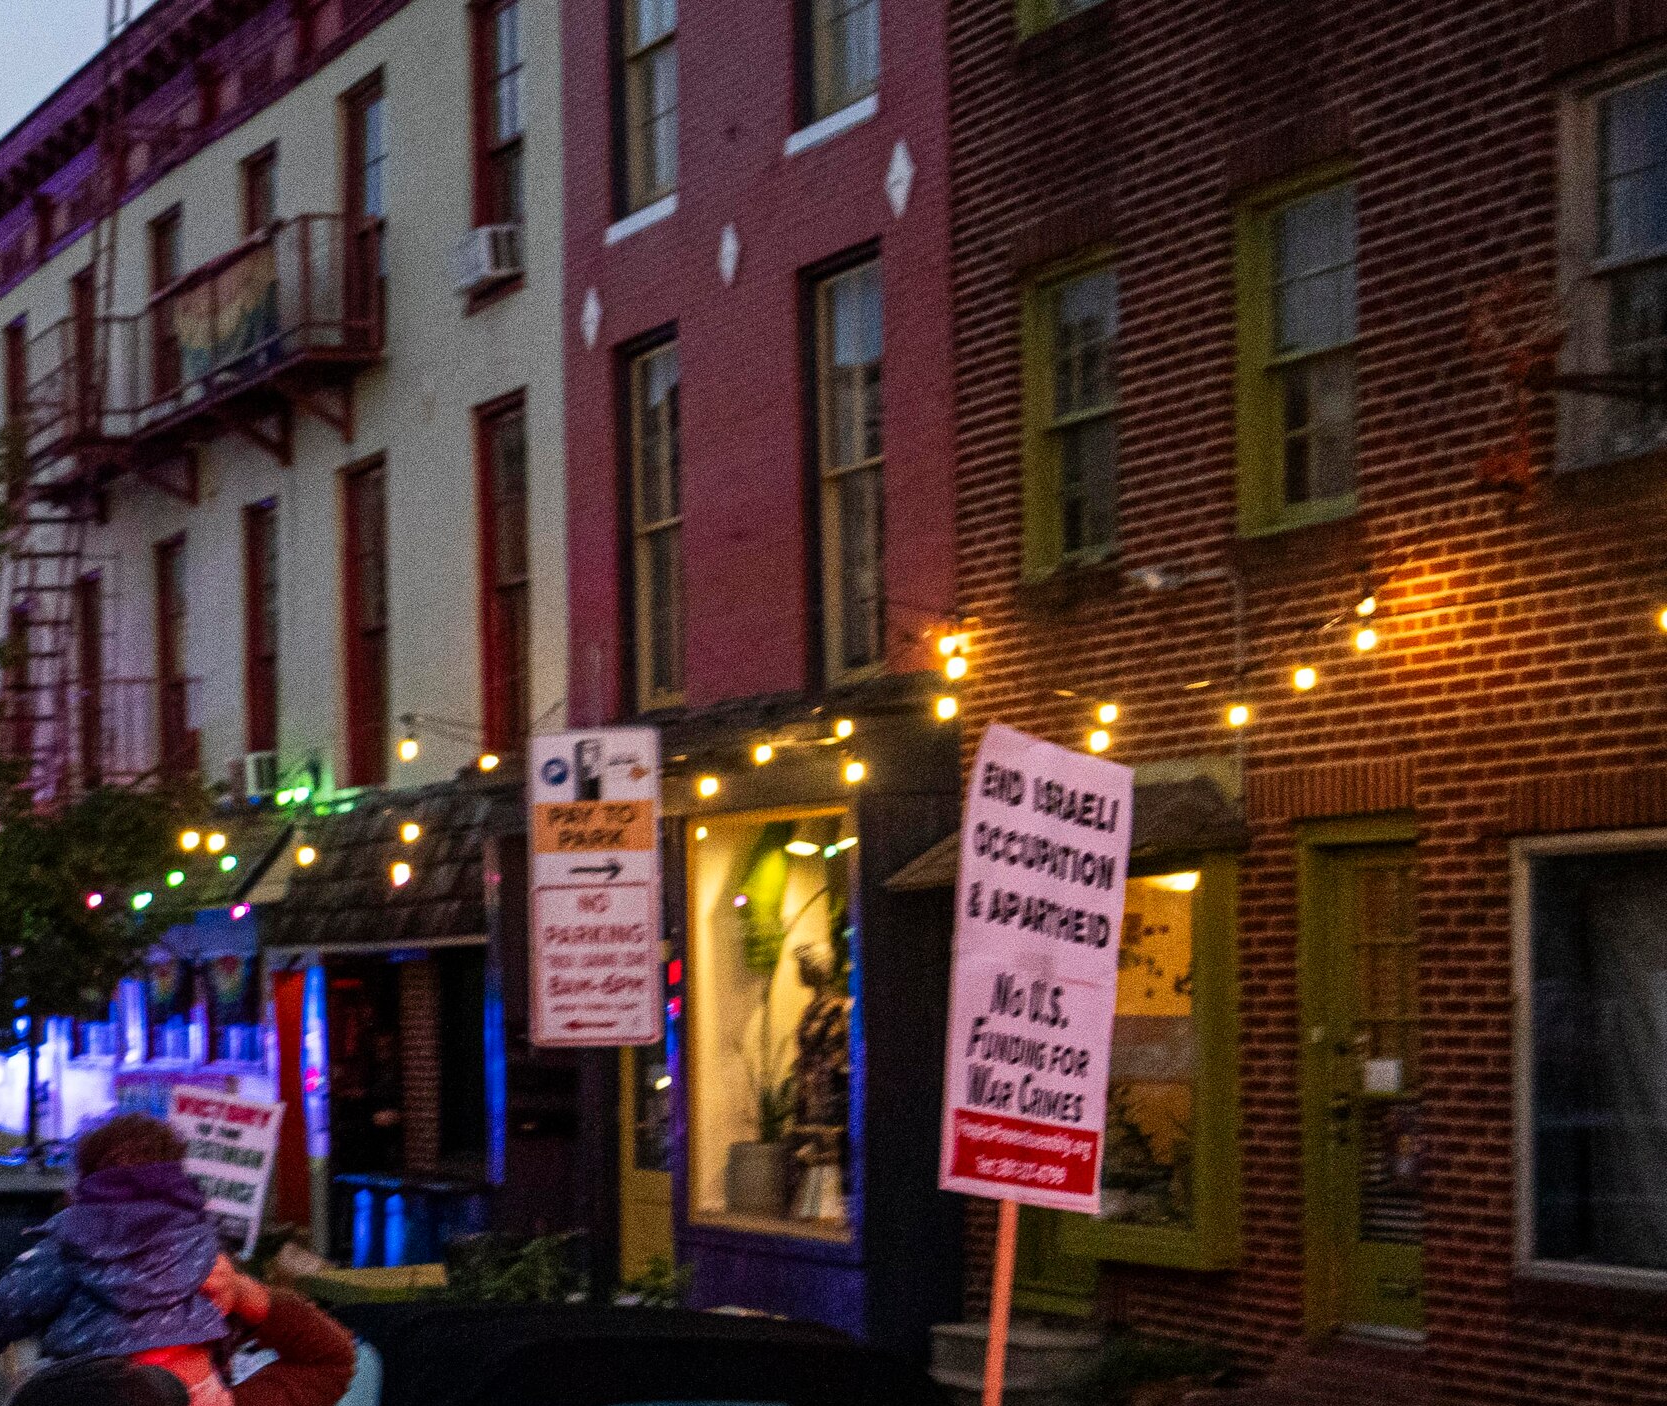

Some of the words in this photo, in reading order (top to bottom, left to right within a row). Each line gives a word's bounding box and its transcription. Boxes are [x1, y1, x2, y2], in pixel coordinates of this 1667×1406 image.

[547, 804, 593, 828] PAY
[603, 803, 636, 825] TO
[981, 761, 1026, 807] END
[1032, 775, 1120, 834] ISRAELI
[558, 827, 626, 850] PARK
[973, 820, 1116, 892] OCCUPATION
[543, 921, 643, 945] PARKING
[985, 887, 1112, 950] APARTHEID
[1029, 979, 1070, 1030] U.S.
